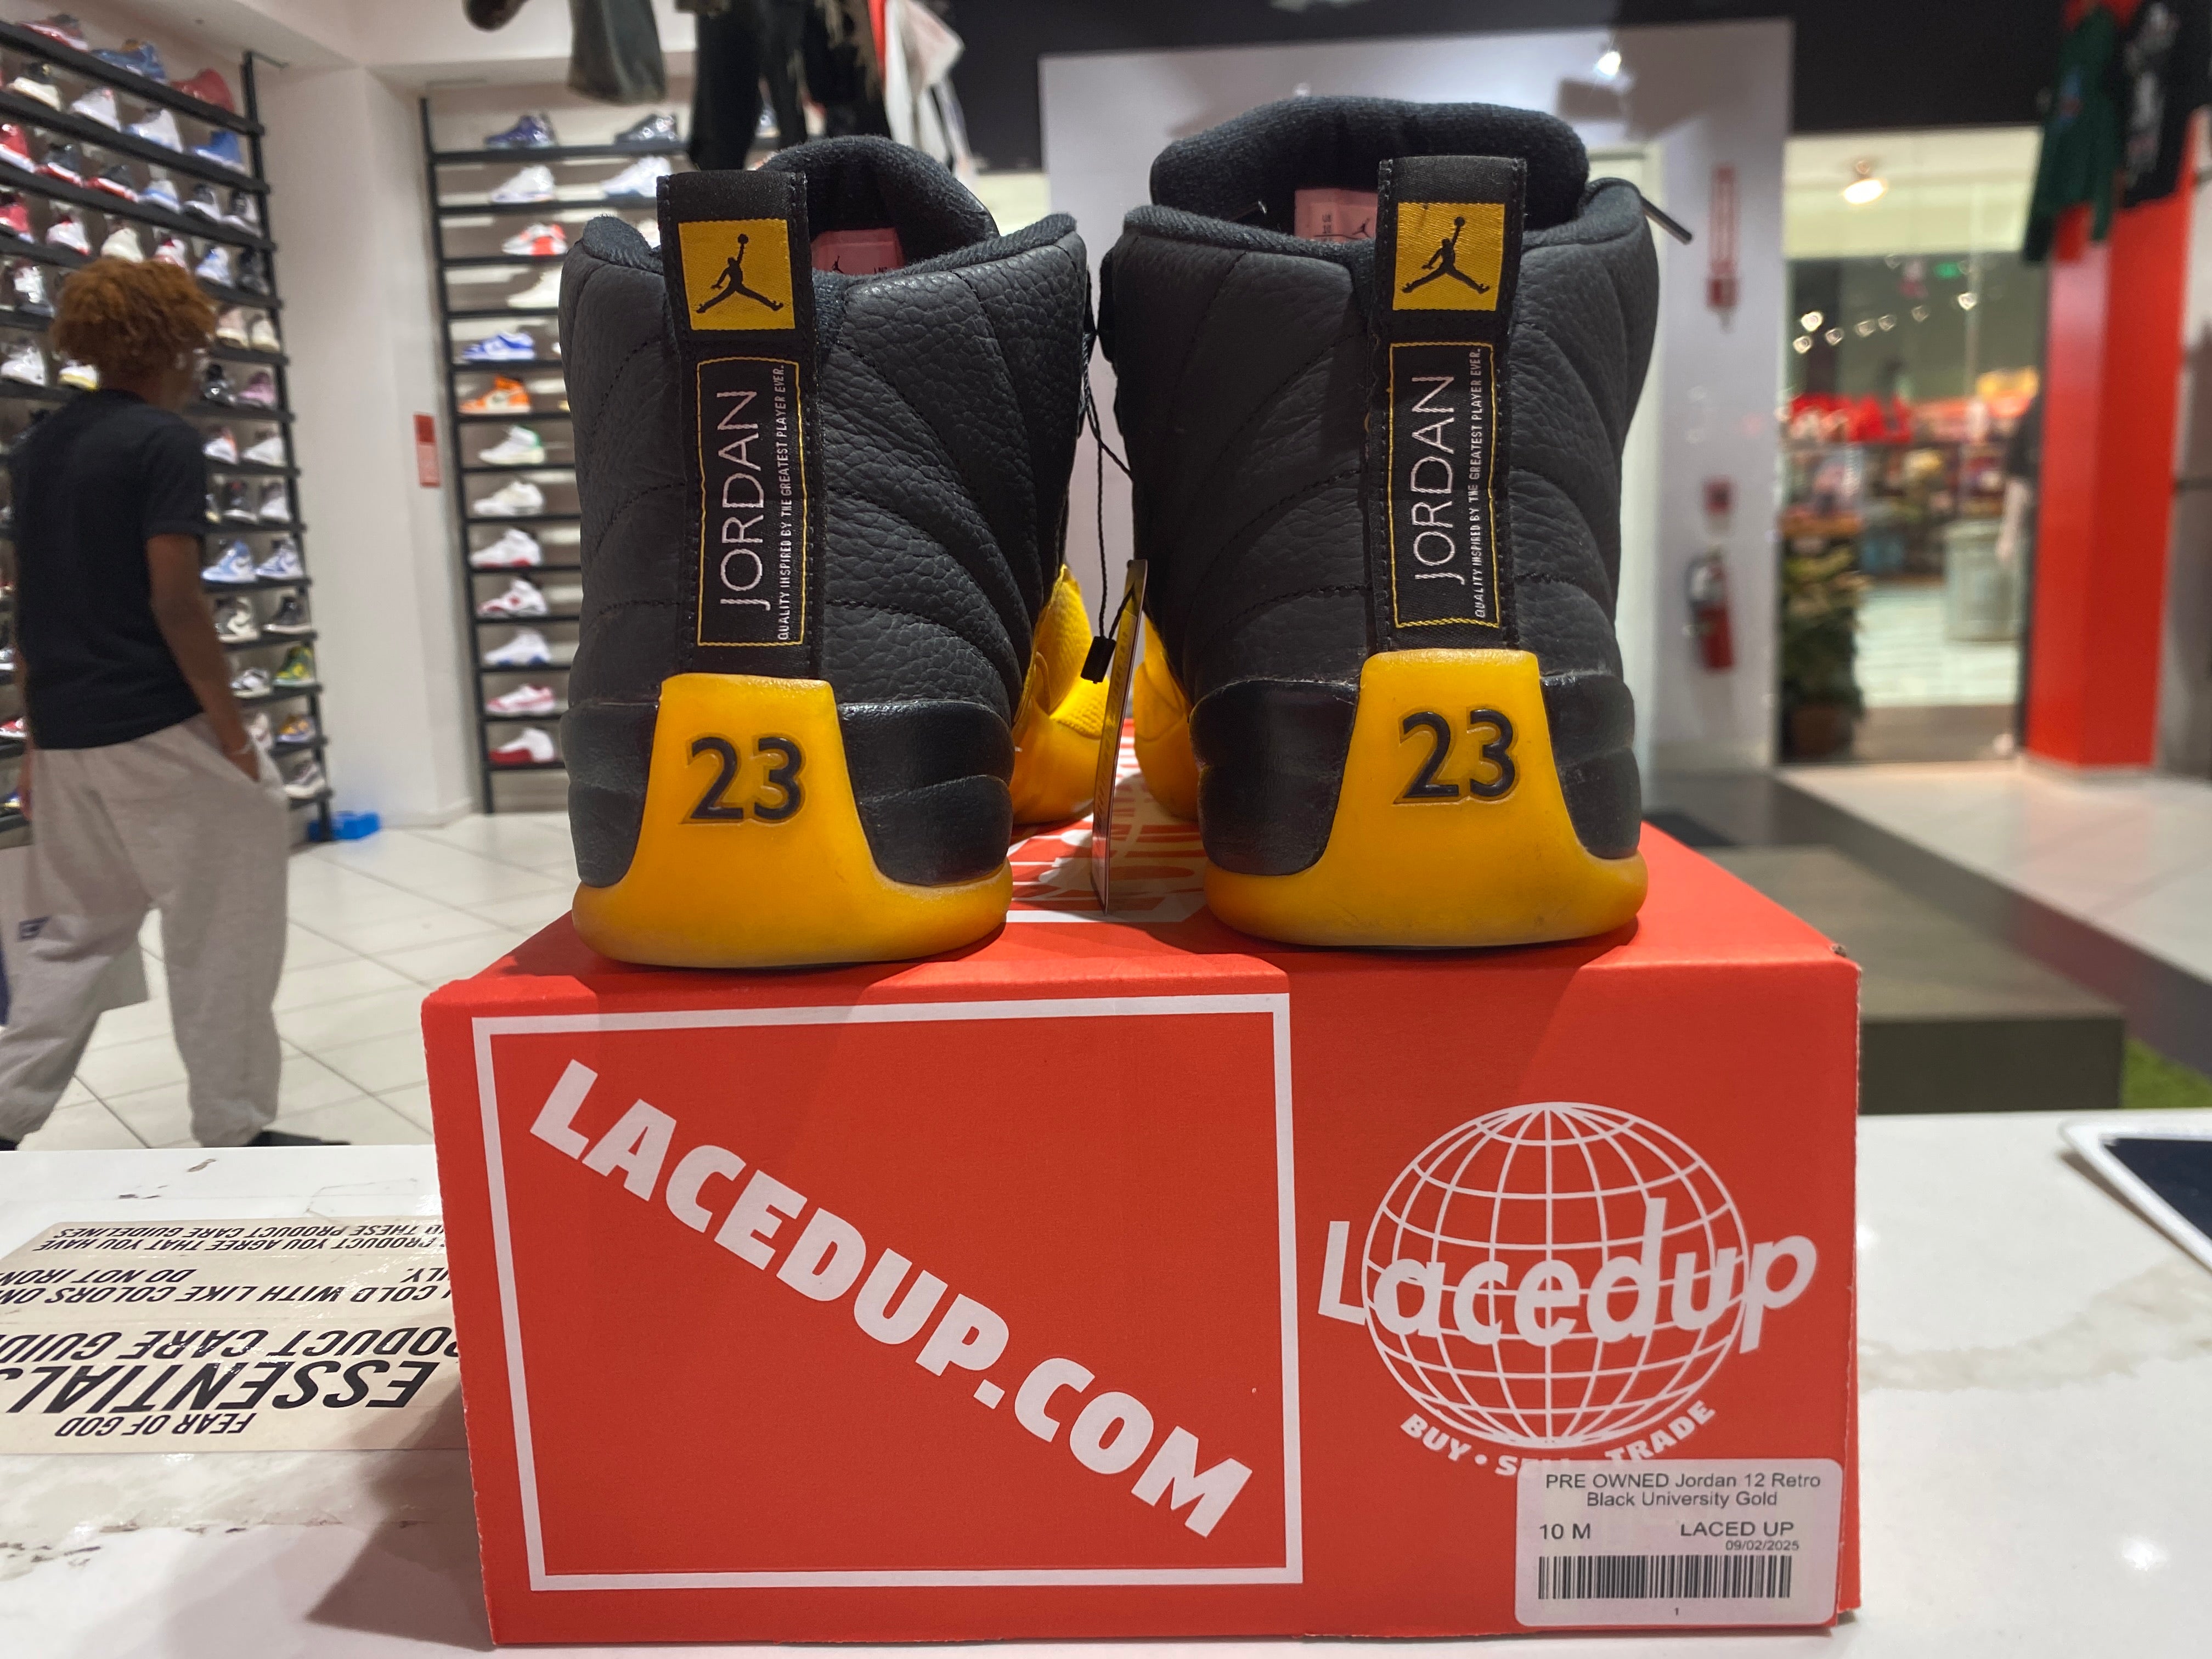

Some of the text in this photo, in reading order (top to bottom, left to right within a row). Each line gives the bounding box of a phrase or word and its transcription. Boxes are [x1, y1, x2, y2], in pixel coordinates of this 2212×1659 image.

[1410, 376, 1465, 585] JORDAN
[1468, 348, 1486, 618] QUALITY INSPIRED BY THE GREATEST PLAYER EVER.
[716, 390, 771, 611] JORDAN
[772, 364, 792, 641] QUALITY INSPIRED BY THE GREATEST PLAYER EVER.
[1399, 707, 1517, 801] 23
[687, 734, 804, 822] 23
[53, 1227, 183, 1238] GUIDELINES
[182, 1227, 245, 1238] CARE
[244, 1225, 349, 1237] PRODUCT
[349, 1224, 420, 1236] THESE
[32, 1239, 97, 1251] HAVE
[95, 1239, 144, 1250] YOU
[145, 1239, 205, 1251] THAT
[205, 1239, 283, 1251] AGREE
[281, 1238, 328, 1250] YOU
[331, 1237, 437, 1249] PRODUCT
[71, 1269, 148, 1283] NOT
[145, 1269, 198, 1283] DO
[1317, 1197, 1819, 1353] Lacedup
[44, 1286, 177, 1303] COLORS
[174, 1286, 258, 1302] LIKE
[256, 1285, 347, 1302] WITH
[350, 1285, 438, 1302] COLD
[530, 1058, 1252, 1538] LACEDUP.COM
[0, 1331, 122, 1363] GUID
[115, 1330, 268, 1359] CARE
[54, 1413, 256, 1437] FEAR OF GOD
[1604, 1400, 1717, 1462] TRADE
[1400, 1413, 1472, 1462] BUY
[1546, 1472, 1821, 1488] PRE OWNED Jordan 12 Retro
[1587, 1491, 1777, 1509] Black University Gold
[1539, 1523, 1591, 1539] 10 M
[1680, 1521, 1794, 1537] LACED UP
[1725, 1539, 1799, 1551] 09/02/2025
[1674, 1607, 1679, 1616] 1
